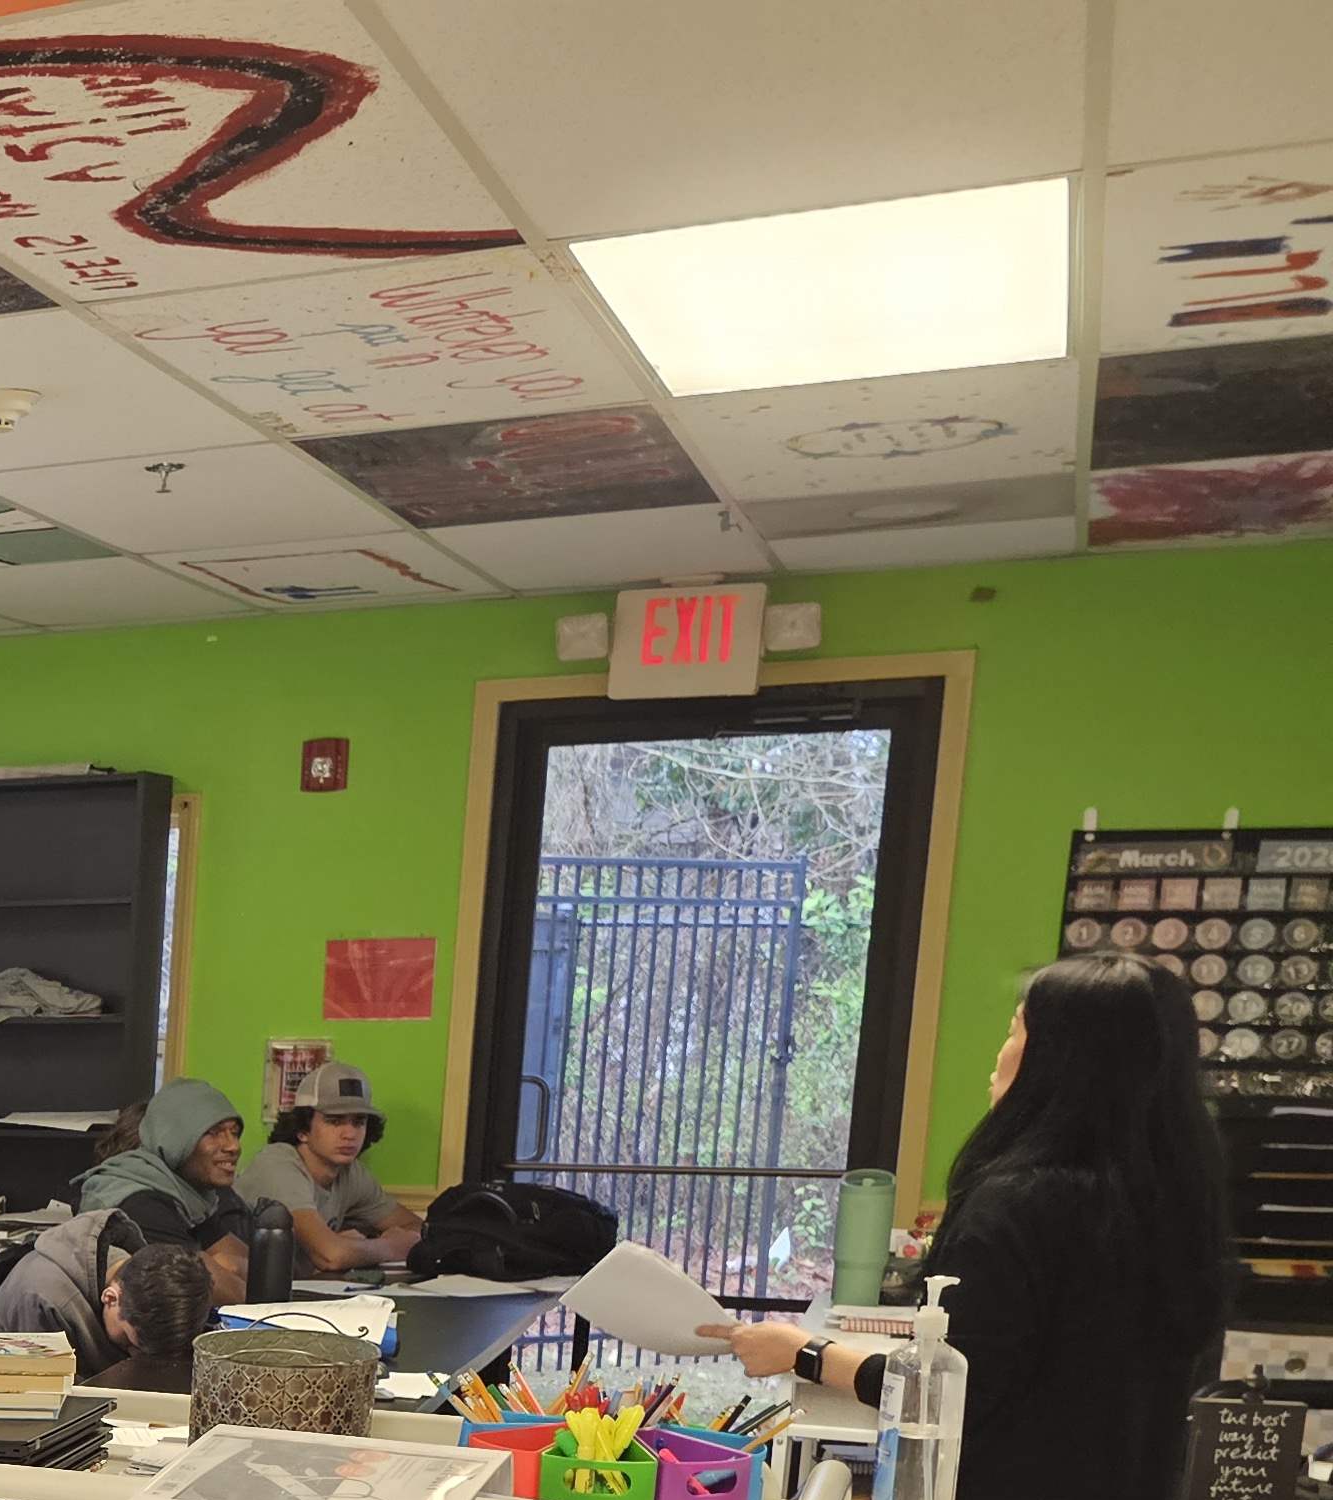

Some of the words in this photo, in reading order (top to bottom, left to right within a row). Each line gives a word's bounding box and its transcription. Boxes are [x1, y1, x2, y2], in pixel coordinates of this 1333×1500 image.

[44, 160, 126, 182] A
[369, 272, 549, 364] Whatever
[134, 318, 305, 356] you
[366, 349, 441, 370] in
[209, 369, 371, 397] get
[446, 368, 588, 403] you
[640, 594, 743, 665] EXIT
[1119, 849, 1196, 868] March
[1275, 846, 1333, 868] 202
[1219, 1407, 1248, 1425] the
[1252, 1410, 1291, 1427] best
[1219, 1429, 1254, 1449] way
[1263, 1427, 1279, 1445] to
[1214, 1445, 1281, 1464] predict
[1220, 1465, 1267, 1484] your
[1210, 1478, 1273, 1497] future
